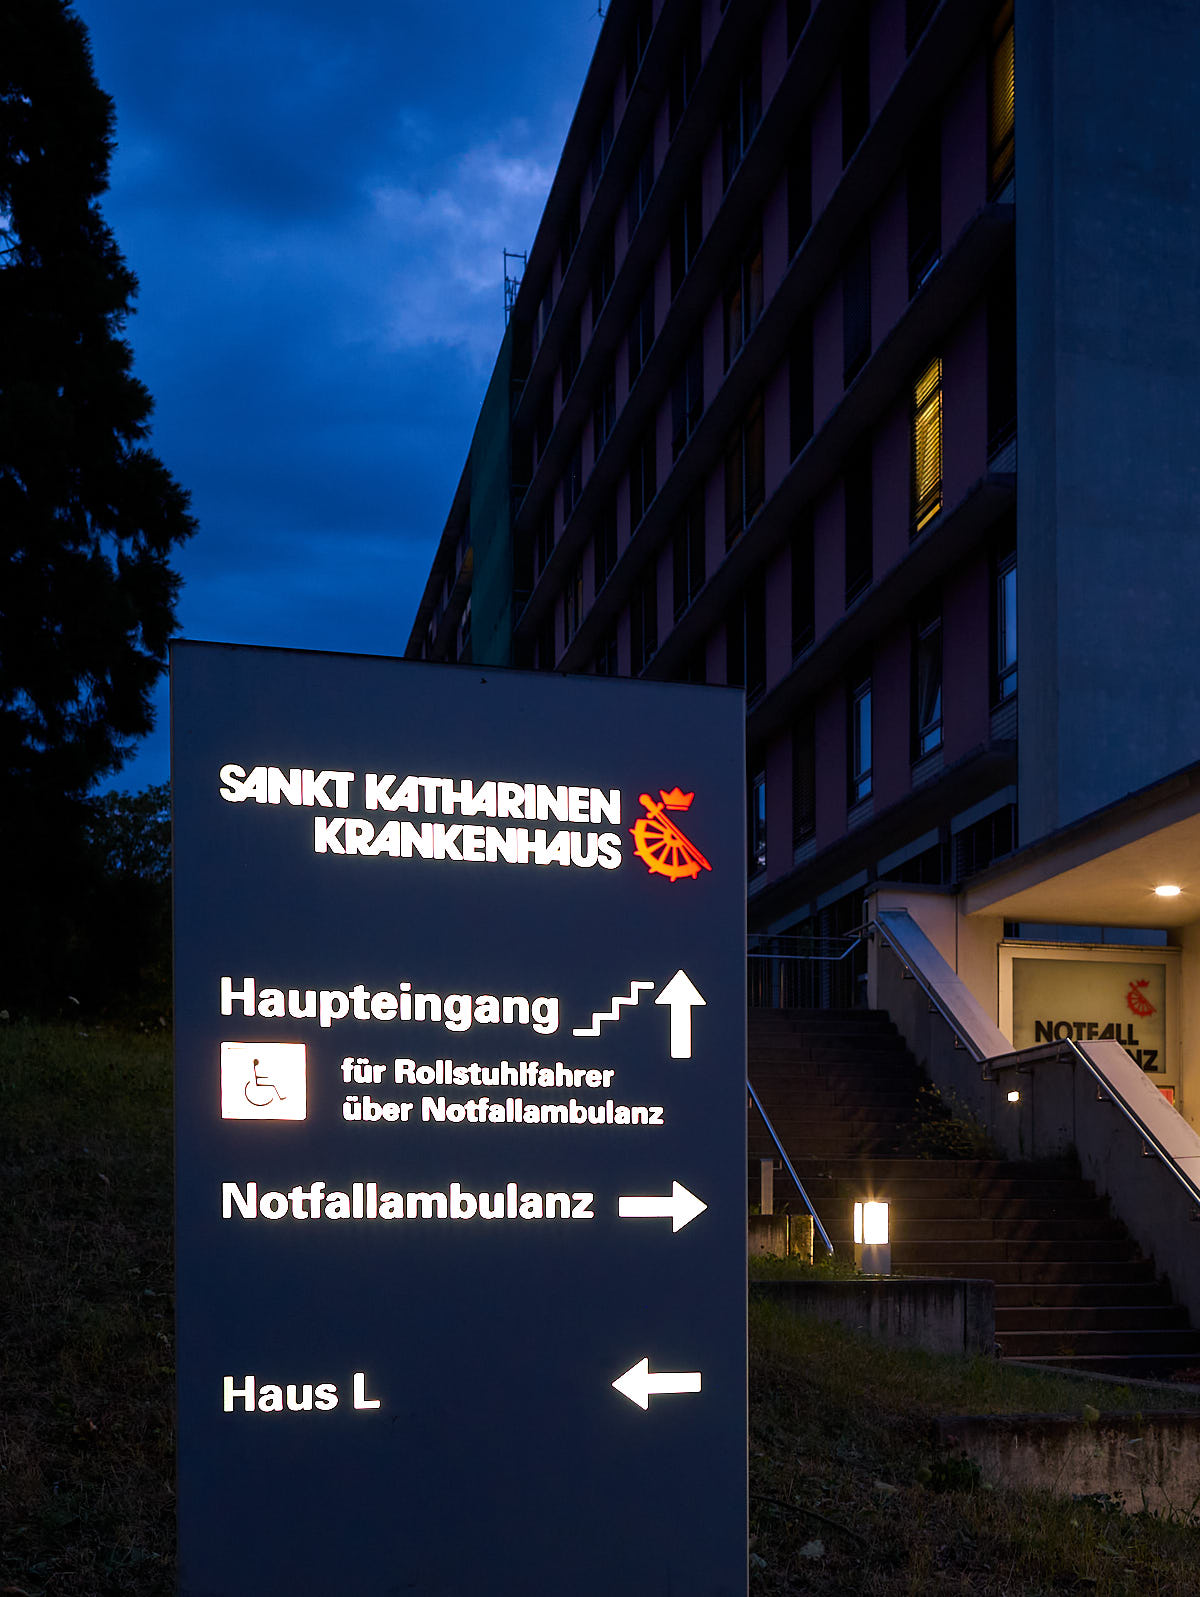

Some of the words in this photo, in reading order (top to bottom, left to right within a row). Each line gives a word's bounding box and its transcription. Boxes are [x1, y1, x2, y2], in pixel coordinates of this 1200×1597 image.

[220, 764, 355, 808] SANKT
[366, 773, 621, 825] KATHARINEN
[314, 816, 622, 870] KRANKENHAUS
[220, 976, 559, 1035] Haupteingang
[1034, 1020, 1139, 1046] NOTFALL
[341, 1056, 387, 1084] für
[394, 1058, 615, 1088] Rollstuhlfahrer
[342, 1095, 414, 1122] über
[421, 1096, 665, 1125] Notfallambulanz
[222, 1181, 595, 1220] Notfallambulanz
[223, 1375, 339, 1413] Haus
[353, 1372, 381, 1410] L
